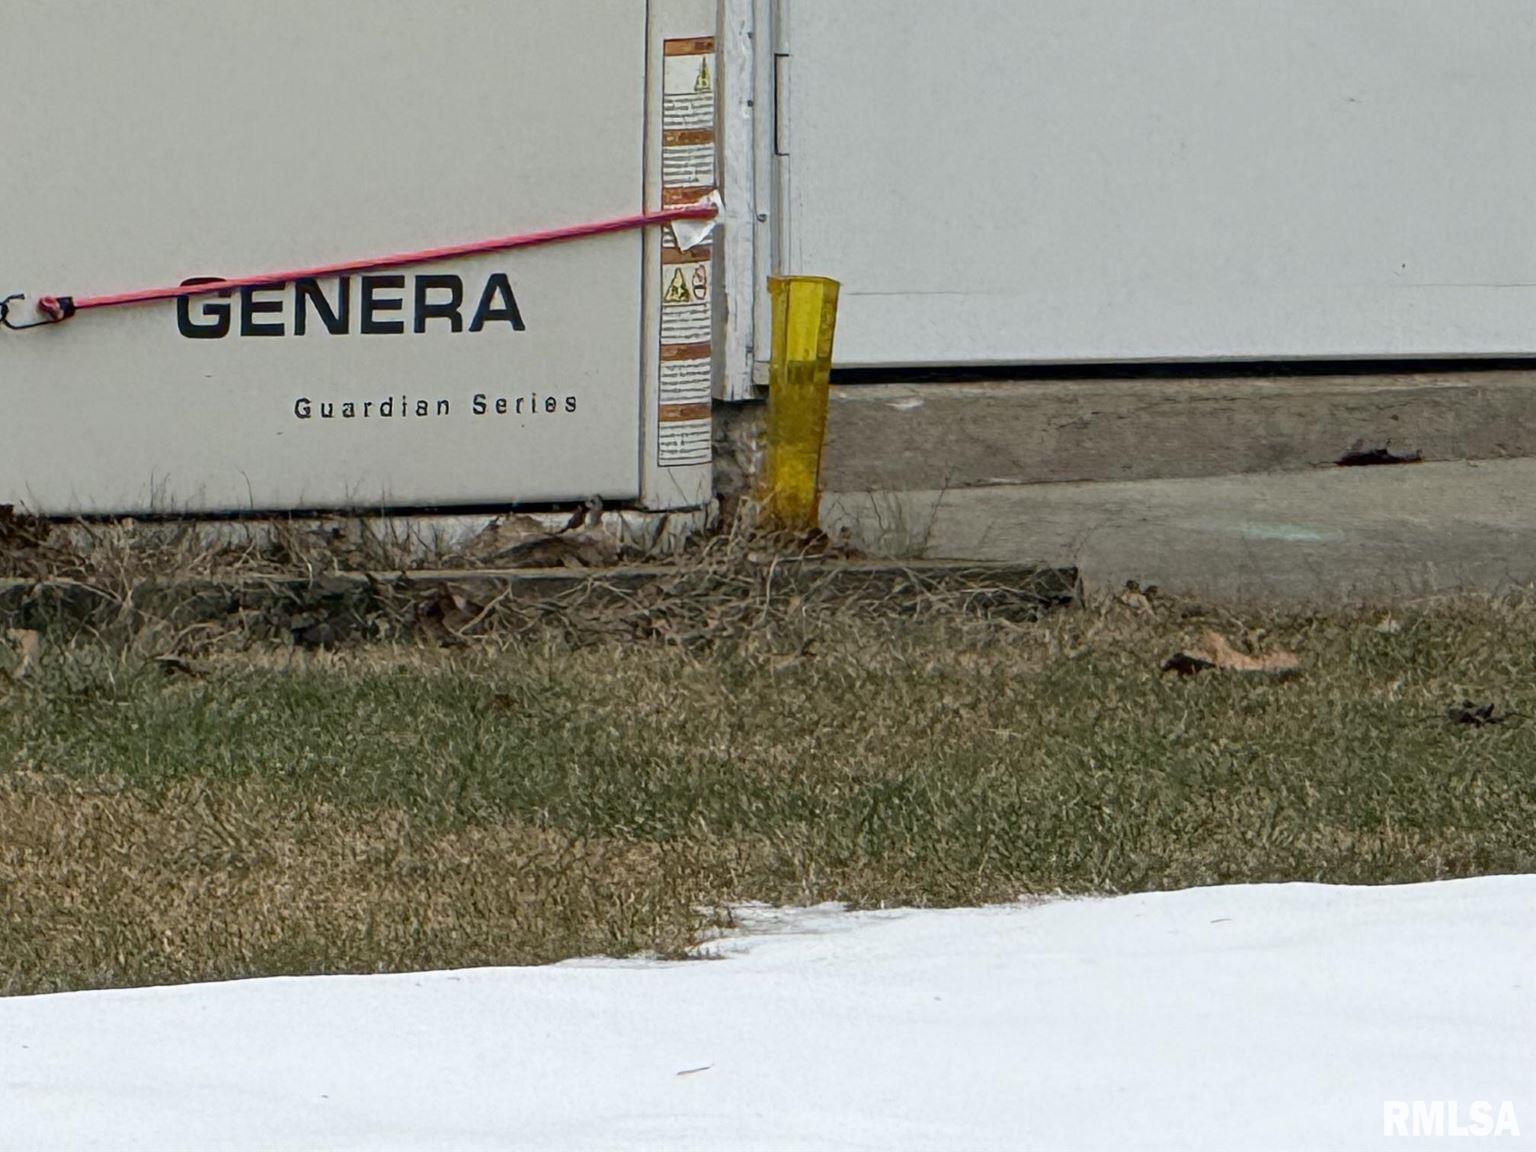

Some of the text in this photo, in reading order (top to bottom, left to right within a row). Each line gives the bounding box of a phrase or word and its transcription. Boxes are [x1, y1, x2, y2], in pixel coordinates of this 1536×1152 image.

[176, 273, 526, 339] GENERA
[293, 392, 578, 419] Guardian Series
